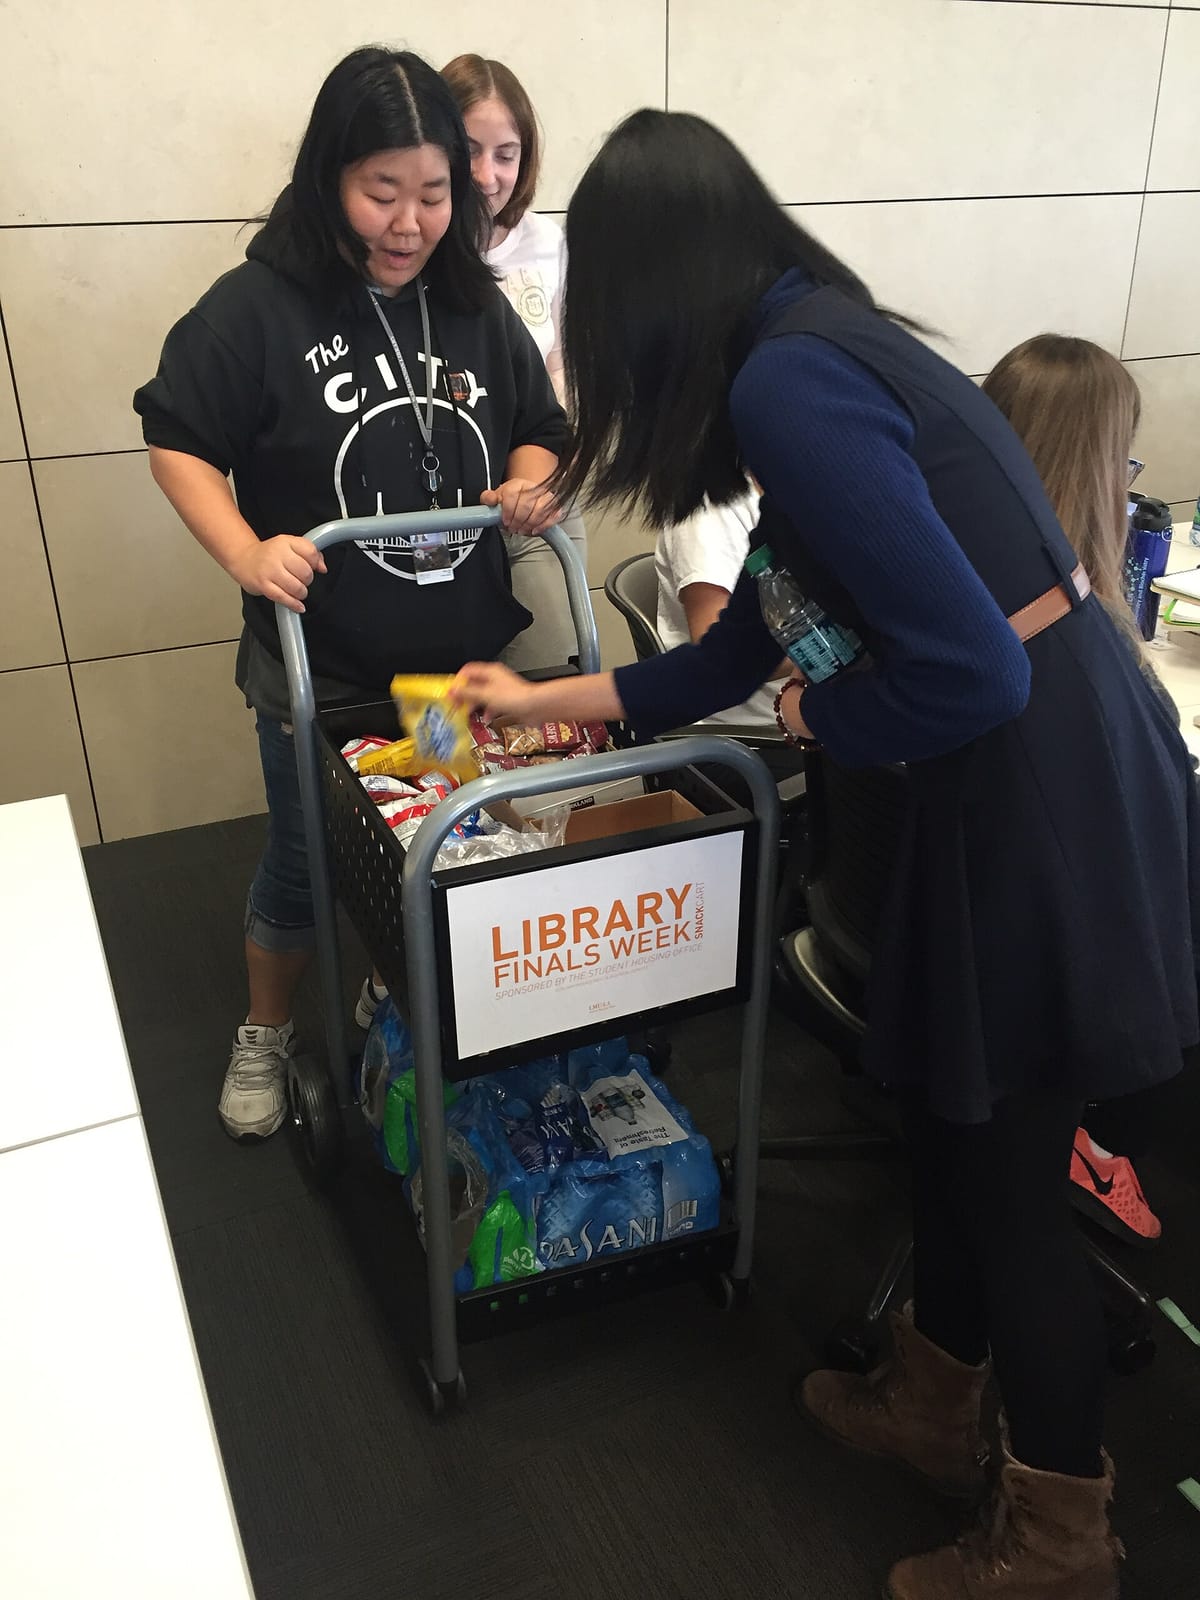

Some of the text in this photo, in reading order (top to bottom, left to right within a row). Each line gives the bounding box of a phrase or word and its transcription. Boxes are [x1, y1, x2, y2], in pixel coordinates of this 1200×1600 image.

[304, 334, 349, 374] The
[323, 351, 488, 414] CITY
[491, 883, 693, 962] LIBRARY
[494, 943, 601, 988] FINALS
[609, 920, 691, 960] WEEK
[495, 979, 553, 1001] SPONSORED
[554, 976, 566, 987] BY
[568, 971, 586, 982] THE
[589, 960, 629, 979] STUDENT
[630, 951, 671, 968] HOUSING
[672, 943, 703, 957] OFFICE
[614, 1126, 667, 1144] Refreshment
[631, 1136, 654, 1145] Taste
[654, 1132, 671, 1140] The
